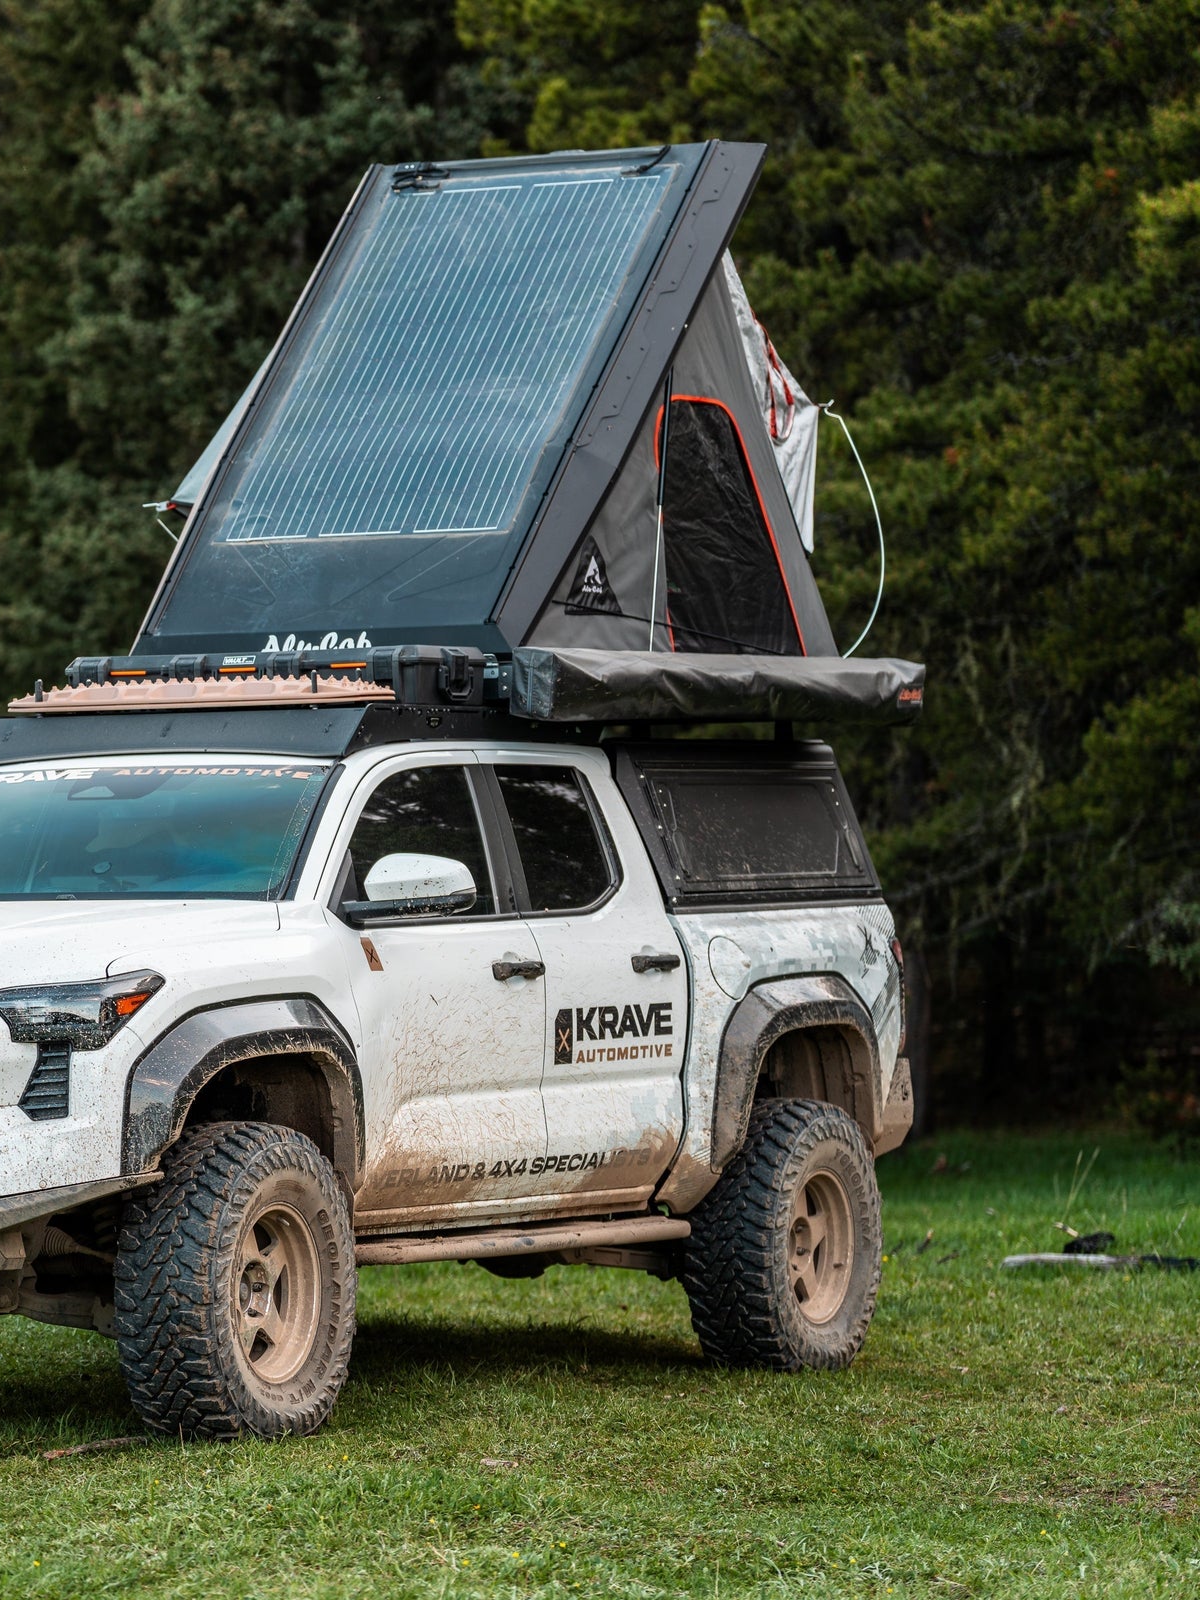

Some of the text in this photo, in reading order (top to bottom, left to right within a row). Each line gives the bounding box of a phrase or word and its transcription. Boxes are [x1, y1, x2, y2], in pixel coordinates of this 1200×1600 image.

[223, 656, 247, 664] VAULT
[113, 766, 314, 780] AUTOMOTIVE
[576, 1002, 673, 1041] KRAVE
[576, 1044, 673, 1063] AUTOMOTIVE
[471, 1162, 486, 1180] &
[488, 1158, 527, 1178] 4X4
[834, 1147, 871, 1247] YOKOHAMA
[313, 1208, 341, 1380] GEOLANDAR
[287, 1378, 317, 1405] M/T
